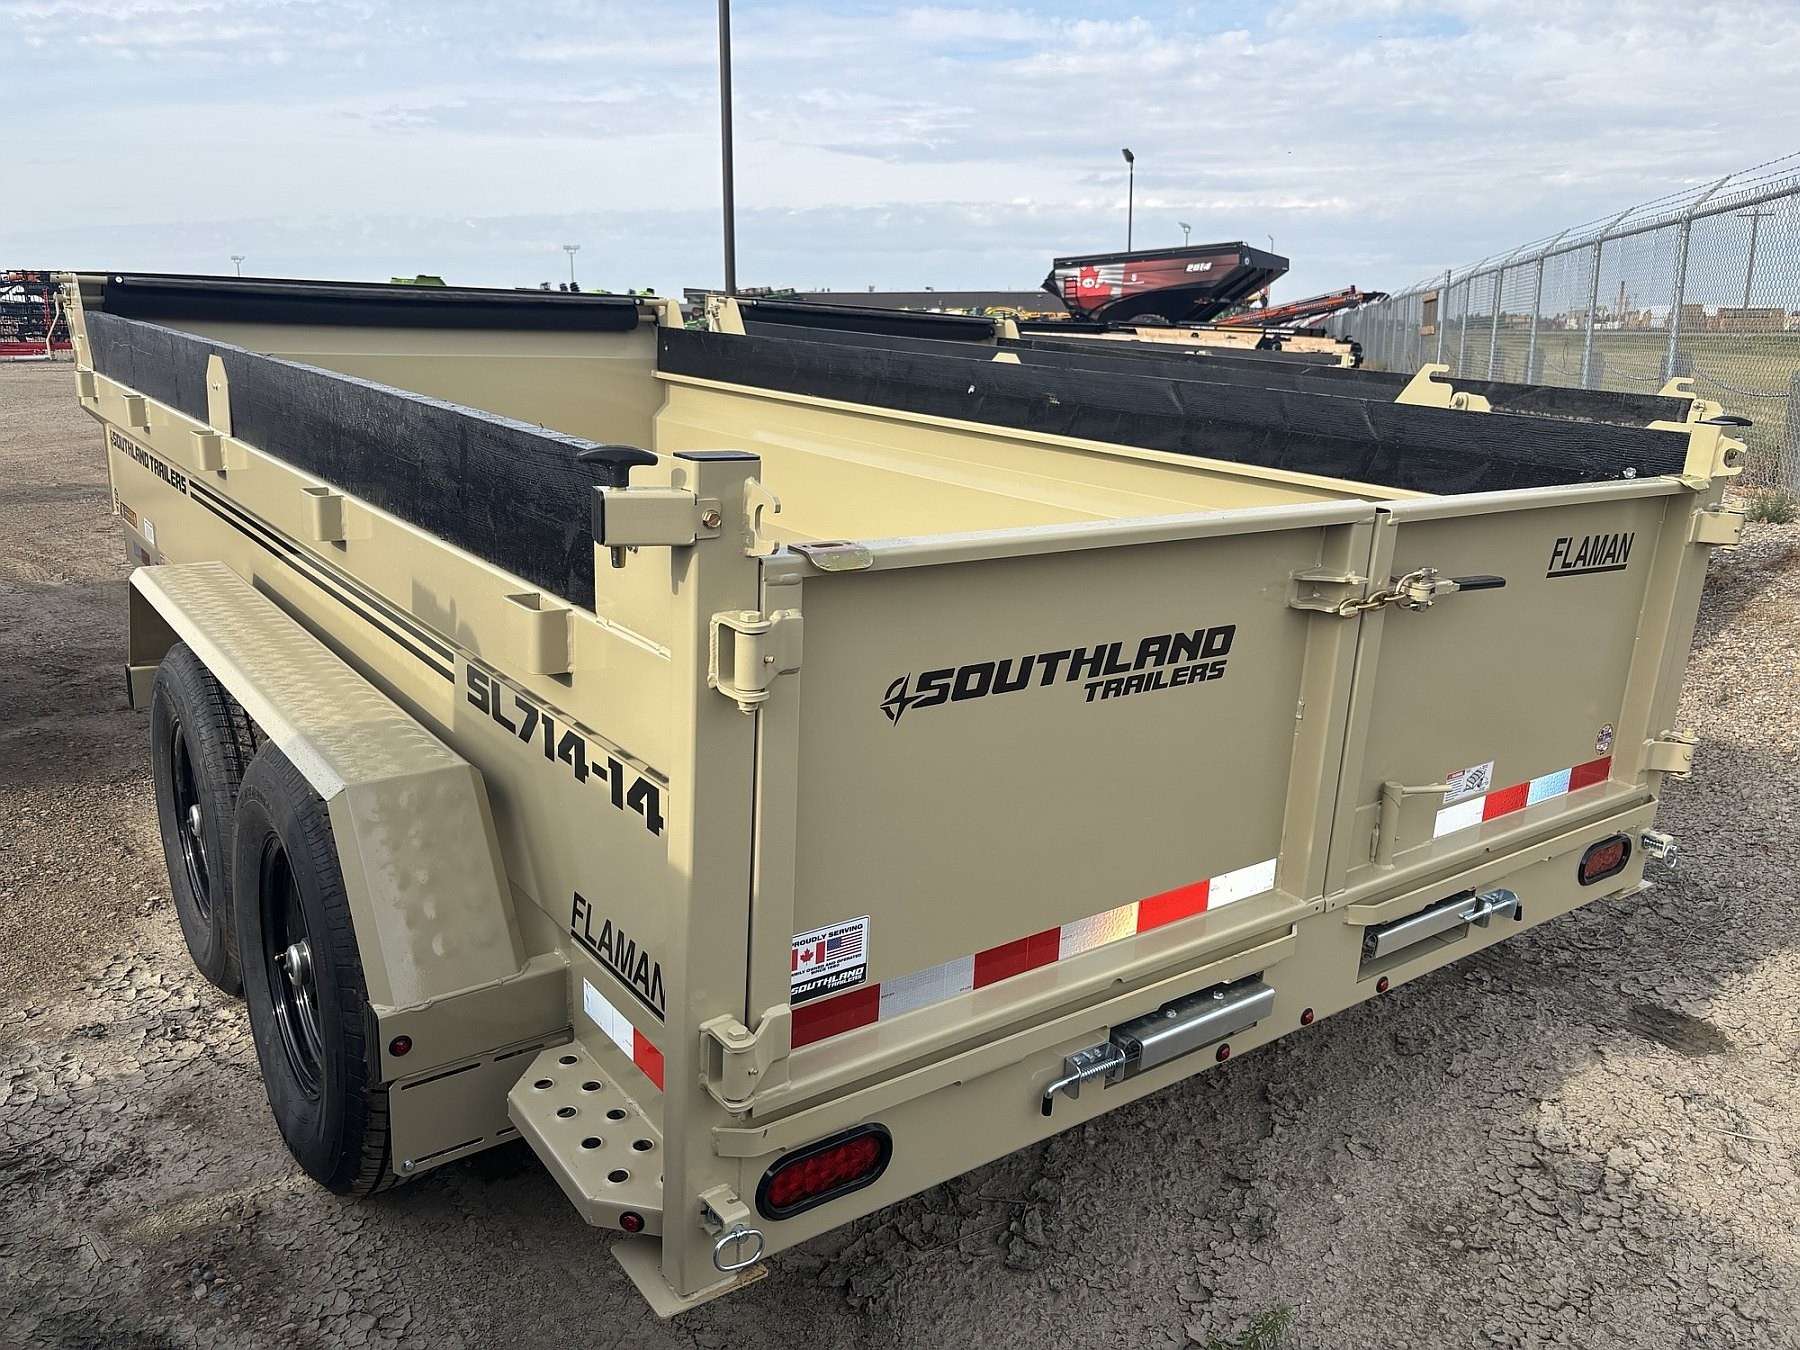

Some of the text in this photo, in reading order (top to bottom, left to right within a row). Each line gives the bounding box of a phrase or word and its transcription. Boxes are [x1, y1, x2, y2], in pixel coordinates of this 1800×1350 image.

[111, 431, 187, 495] SOUTHLAND TRAILERS
[1548, 532, 1635, 571] FLAMAN
[911, 624, 1236, 710] SOUTHLAND
[1084, 659, 1228, 703] TRAILERS
[466, 664, 665, 837] SL714-14
[571, 890, 666, 1013] FLAMAN
[828, 923, 863, 938] SERVING
[791, 966, 864, 996] SOUTHLAND
[827, 974, 863, 989] TRAILERS
